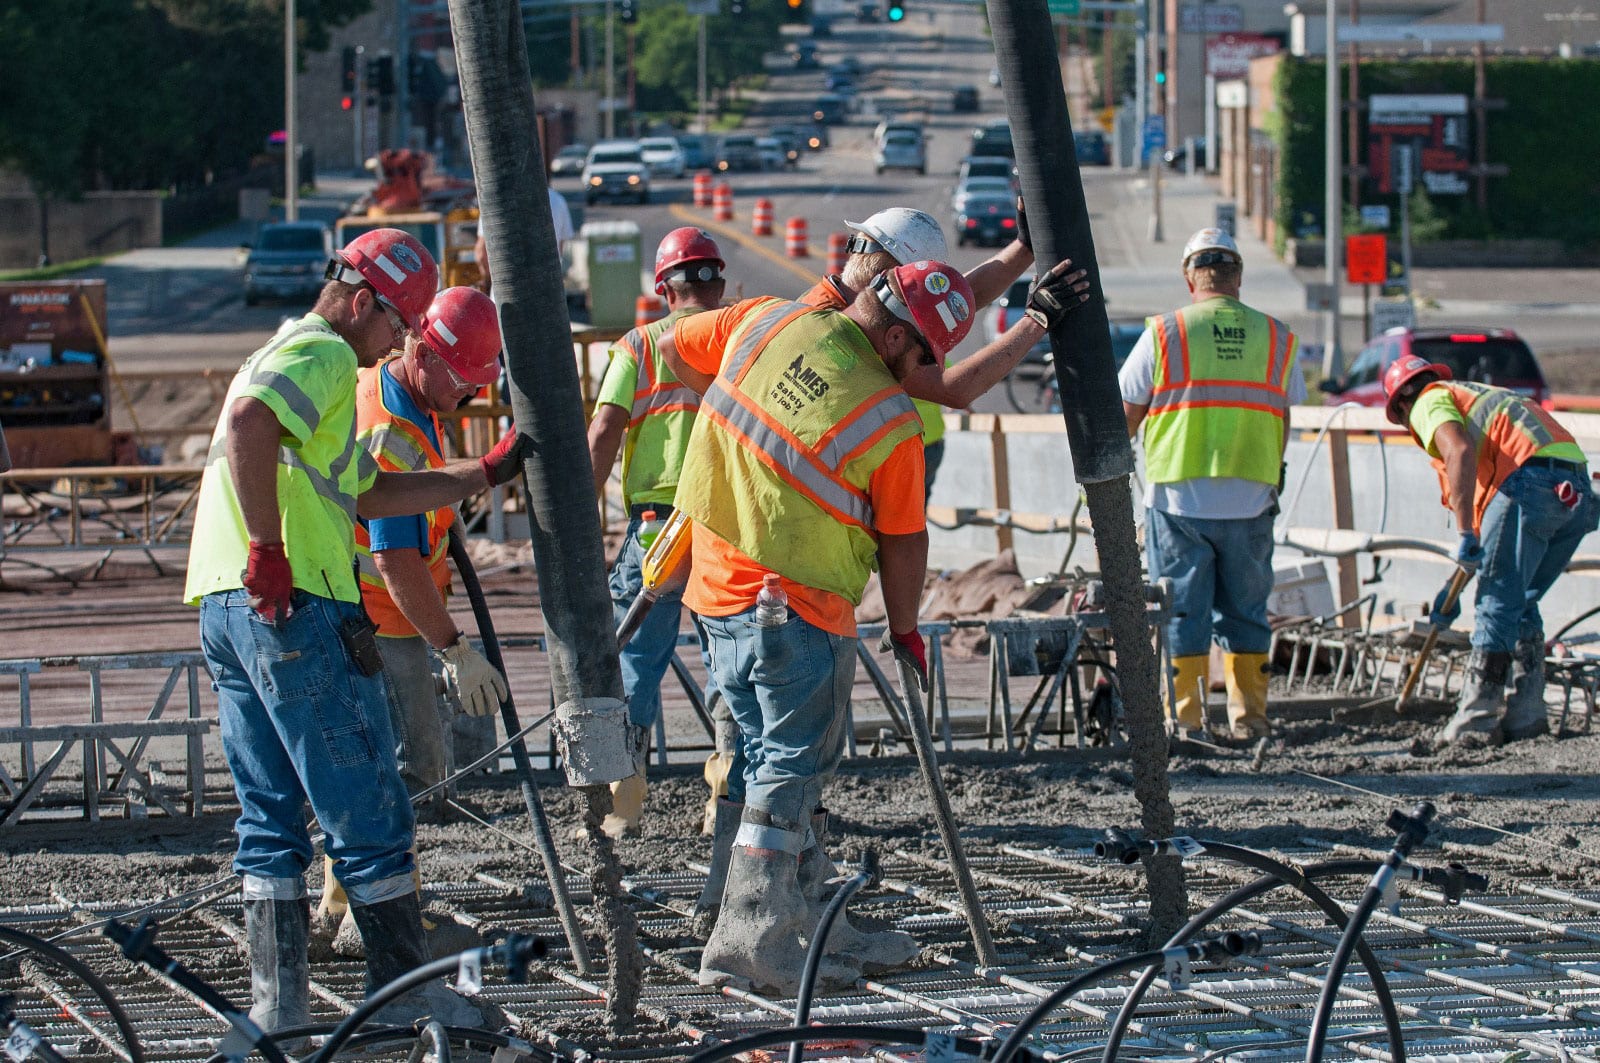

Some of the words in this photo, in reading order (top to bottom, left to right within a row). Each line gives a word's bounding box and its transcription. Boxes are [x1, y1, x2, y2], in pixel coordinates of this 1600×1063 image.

[1213, 323, 1246, 340] AMES
[788, 353, 830, 398] AMES
[770, 390, 779, 399] is
[776, 396, 792, 411] job
[776, 381, 806, 409] Safety
